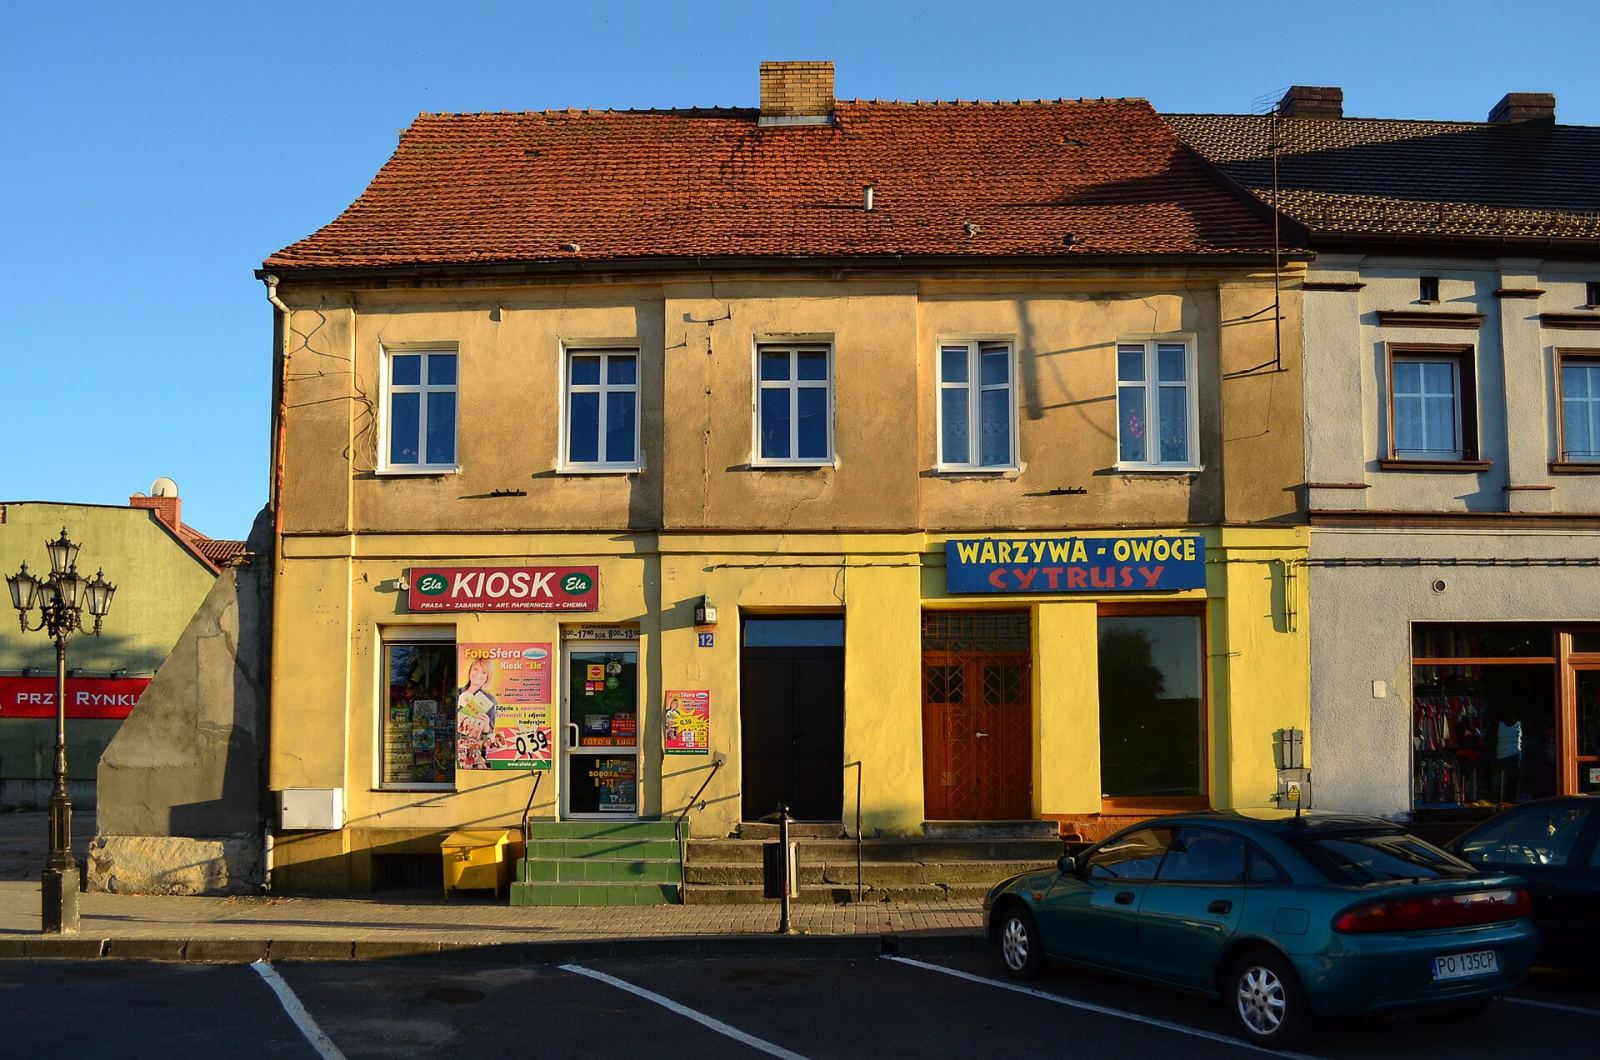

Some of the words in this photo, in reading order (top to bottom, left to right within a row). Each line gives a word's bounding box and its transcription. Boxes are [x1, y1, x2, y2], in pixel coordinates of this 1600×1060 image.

[957, 540, 1088, 564] WARZYWA
[1113, 539, 1196, 562] OWOCE
[421, 578, 442, 591] Ela
[451, 572, 556, 598] KIOSK
[565, 577, 587, 590] Ela
[988, 566, 1165, 590] CYTRUSY
[700, 634, 713, 646] 12
[464, 648, 521, 660] FotoSfera
[17, 693, 66, 705] PRZ
[516, 731, 548, 759] 0,39
[1438, 957, 1456, 974] PO
[1460, 951, 1495, 971] 135CP
